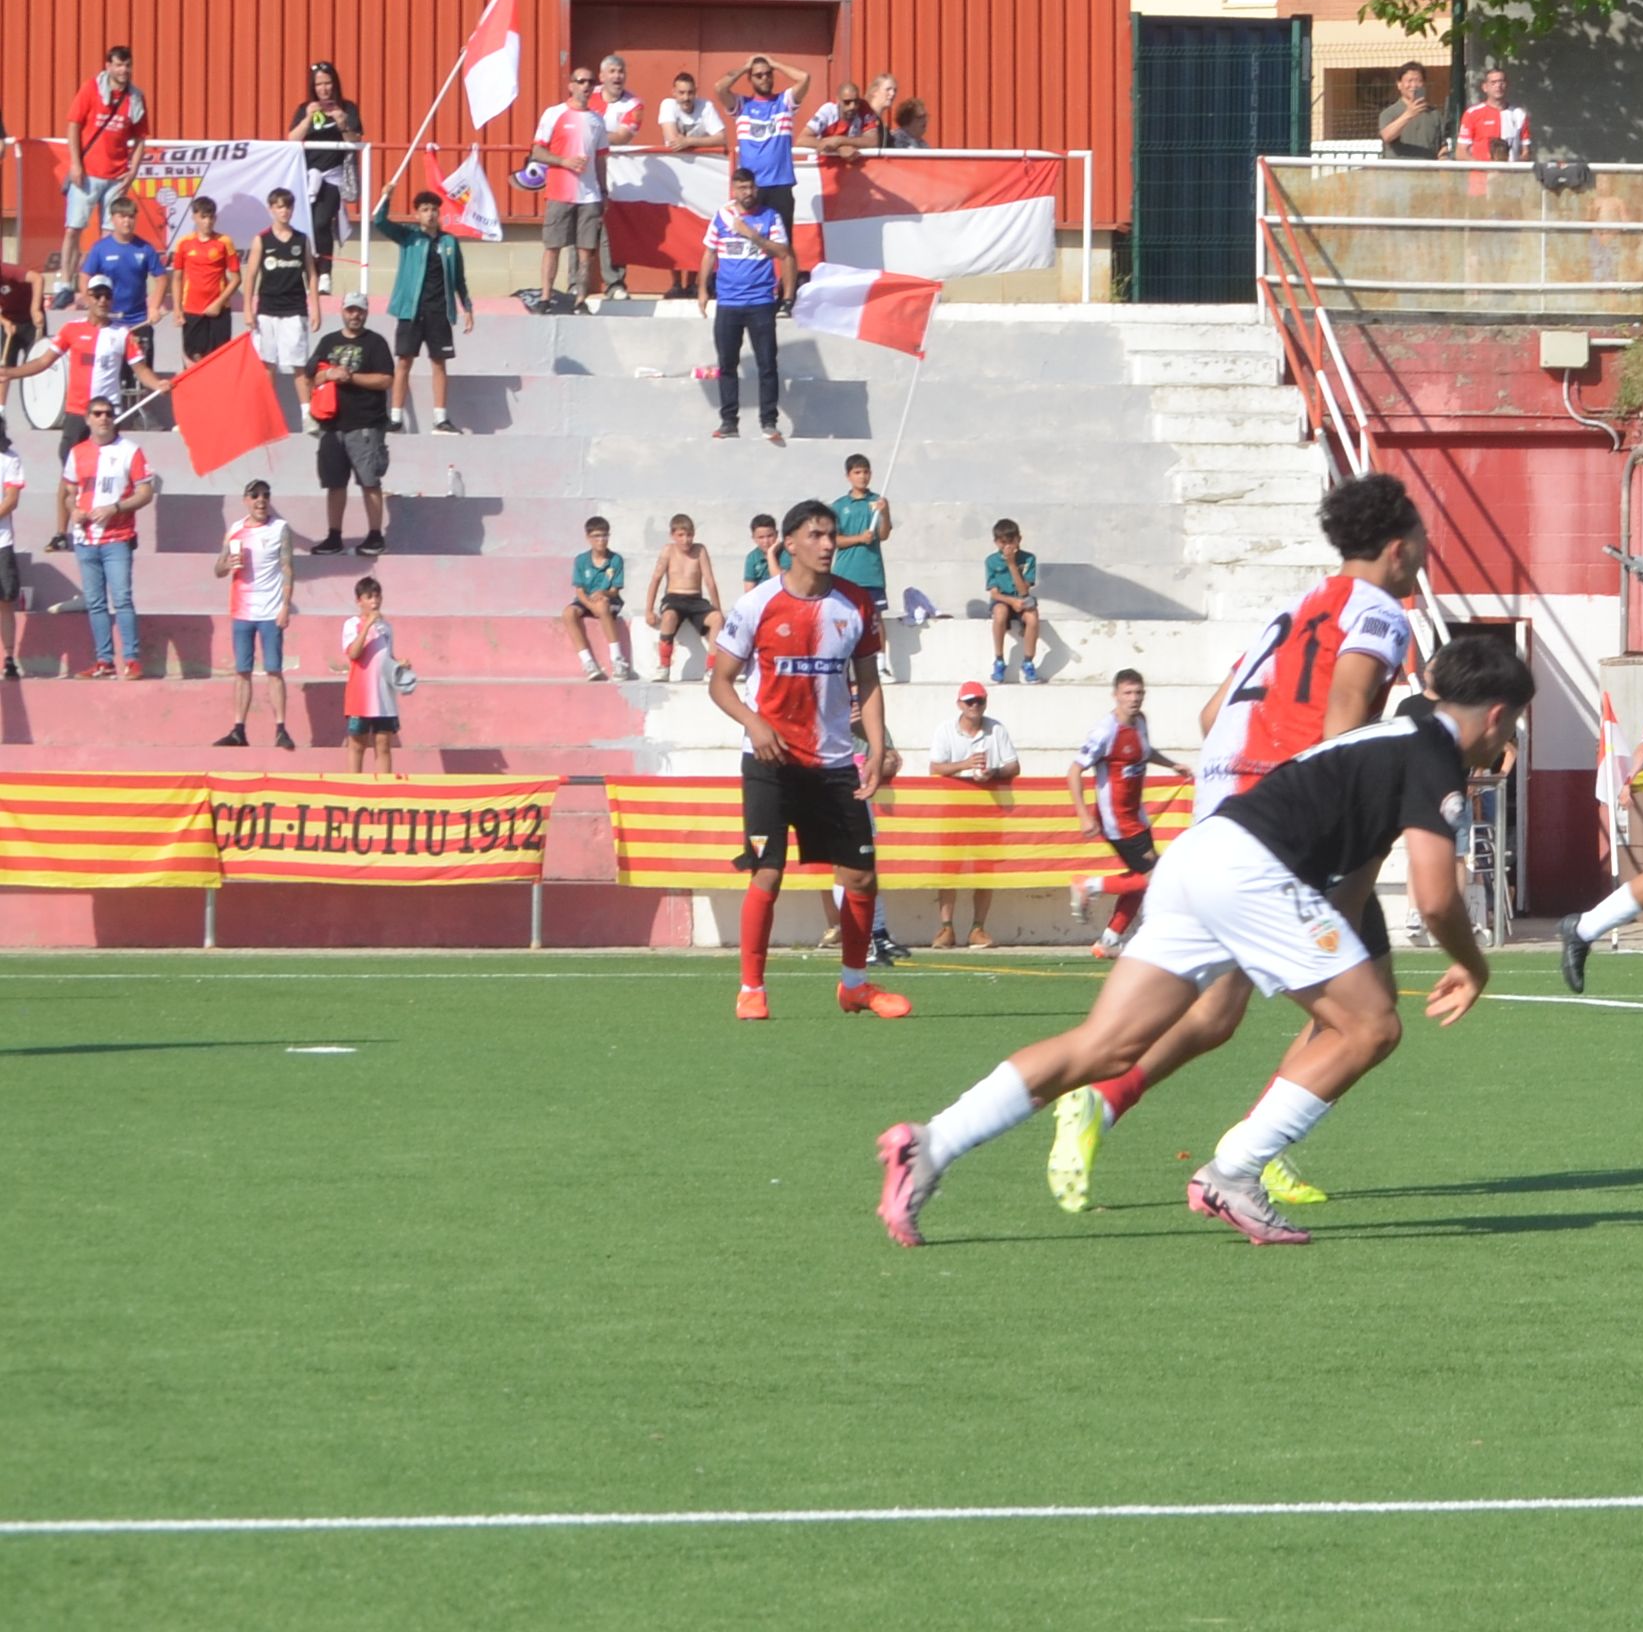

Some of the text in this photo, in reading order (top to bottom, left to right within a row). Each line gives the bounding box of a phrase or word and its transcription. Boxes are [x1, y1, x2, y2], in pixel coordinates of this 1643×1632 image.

[165, 164, 201, 176] Rubi
[1227, 611, 1332, 707] 21
[457, 802, 546, 854] 1912
